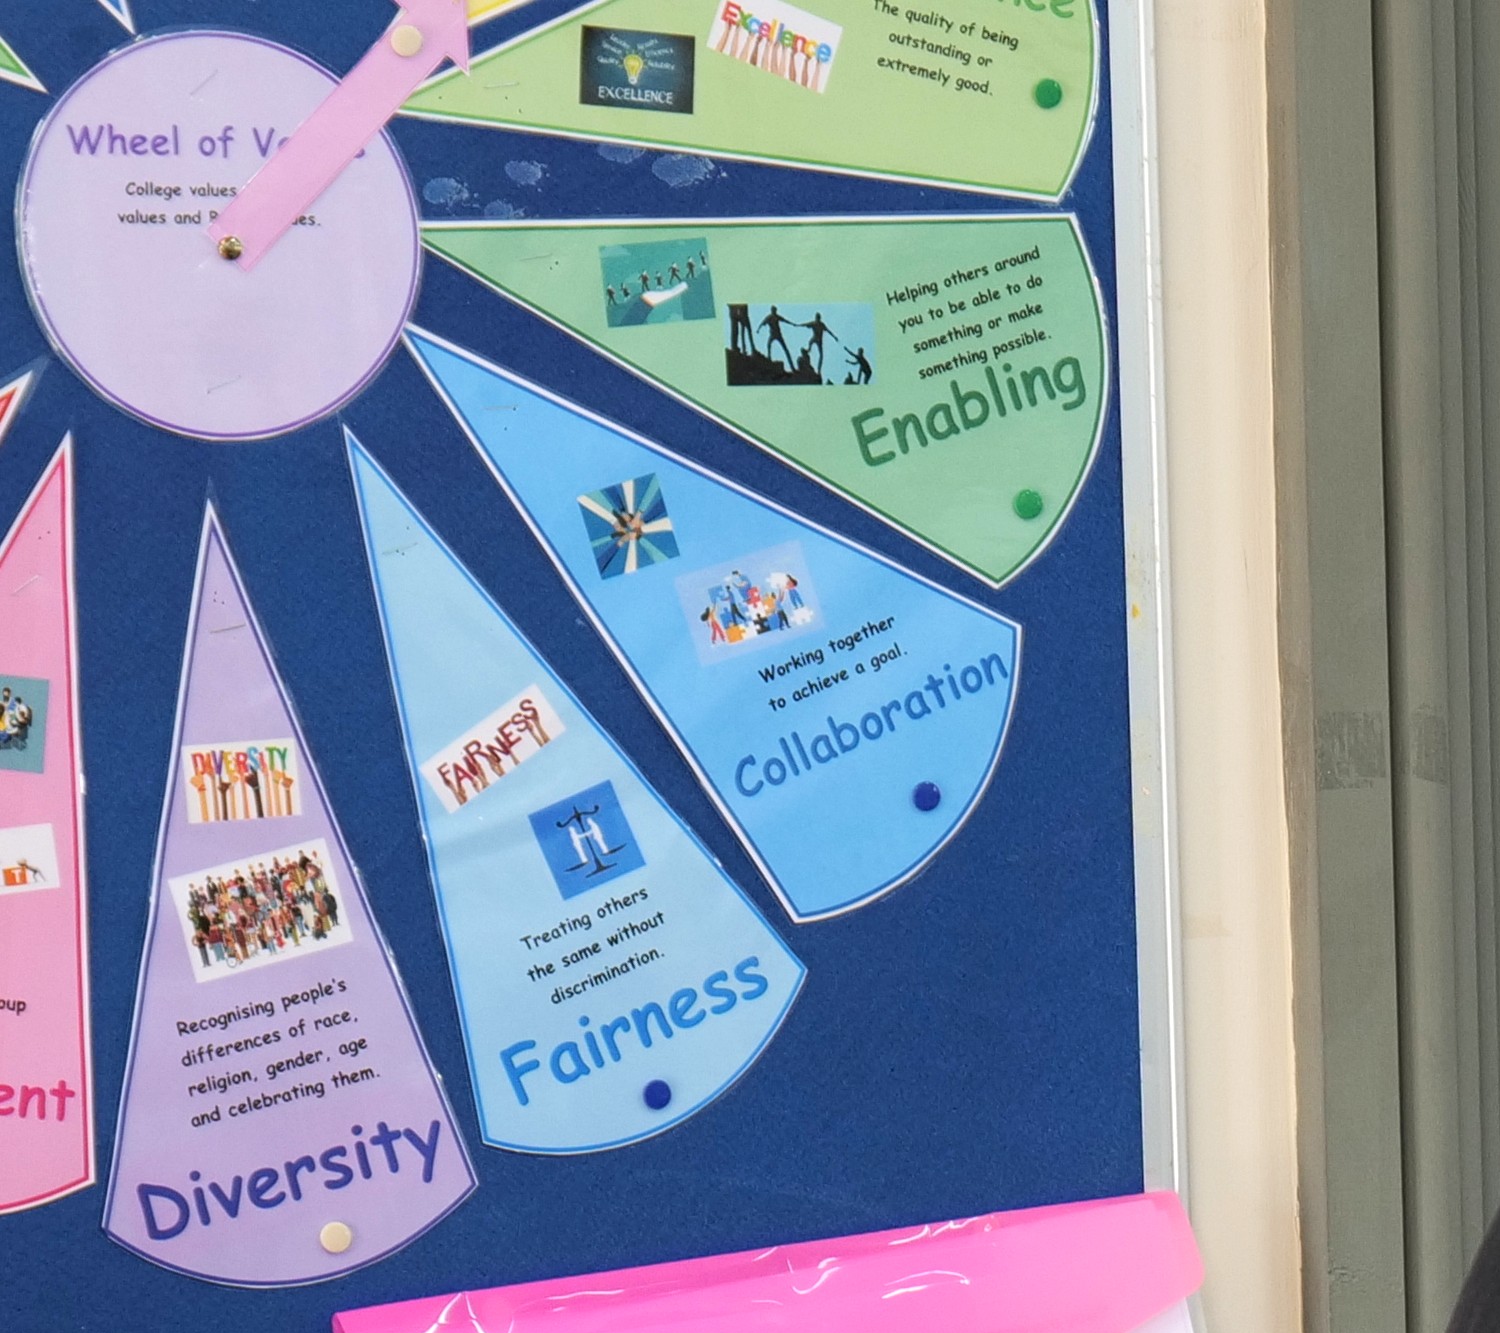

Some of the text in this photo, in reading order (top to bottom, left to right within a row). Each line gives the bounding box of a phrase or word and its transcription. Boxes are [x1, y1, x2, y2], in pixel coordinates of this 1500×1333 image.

[721, 1, 832, 64] Excellence
[873, 0, 1019, 51] The quality of being
[888, 32, 993, 68] outstanding or
[598, 86, 673, 105] EXCELLENCE
[876, 55, 994, 97] extremely good.
[66, 123, 180, 157] Wheel
[198, 125, 236, 160] of
[118, 210, 166, 225] values
[174, 210, 201, 226] and
[125, 182, 237, 200] College values
[886, 245, 1042, 306] Helping others around
[898, 274, 1044, 335] you to be able to do
[912, 302, 1044, 354] something or make
[918, 328, 1053, 380] something possible.
[851, 356, 1088, 468] Enabling
[757, 616, 896, 684] Working together
[767, 642, 909, 713] to achieve a goal.
[437, 698, 540, 783] FAIRNESS
[735, 652, 1009, 798] Collaboration
[190, 746, 289, 777] DIVERSITY
[519, 887, 649, 952] Treating others
[526, 911, 667, 983] the same without
[550, 947, 666, 1005] discrimination.
[175, 978, 348, 1037] Recognising people's
[180, 1008, 359, 1067] differences of race,
[499, 956, 769, 1107] Fairness
[187, 1036, 369, 1098] religion, gender, age
[190, 1064, 381, 1128] and celebrating them.
[136, 1119, 442, 1242] Diversity
